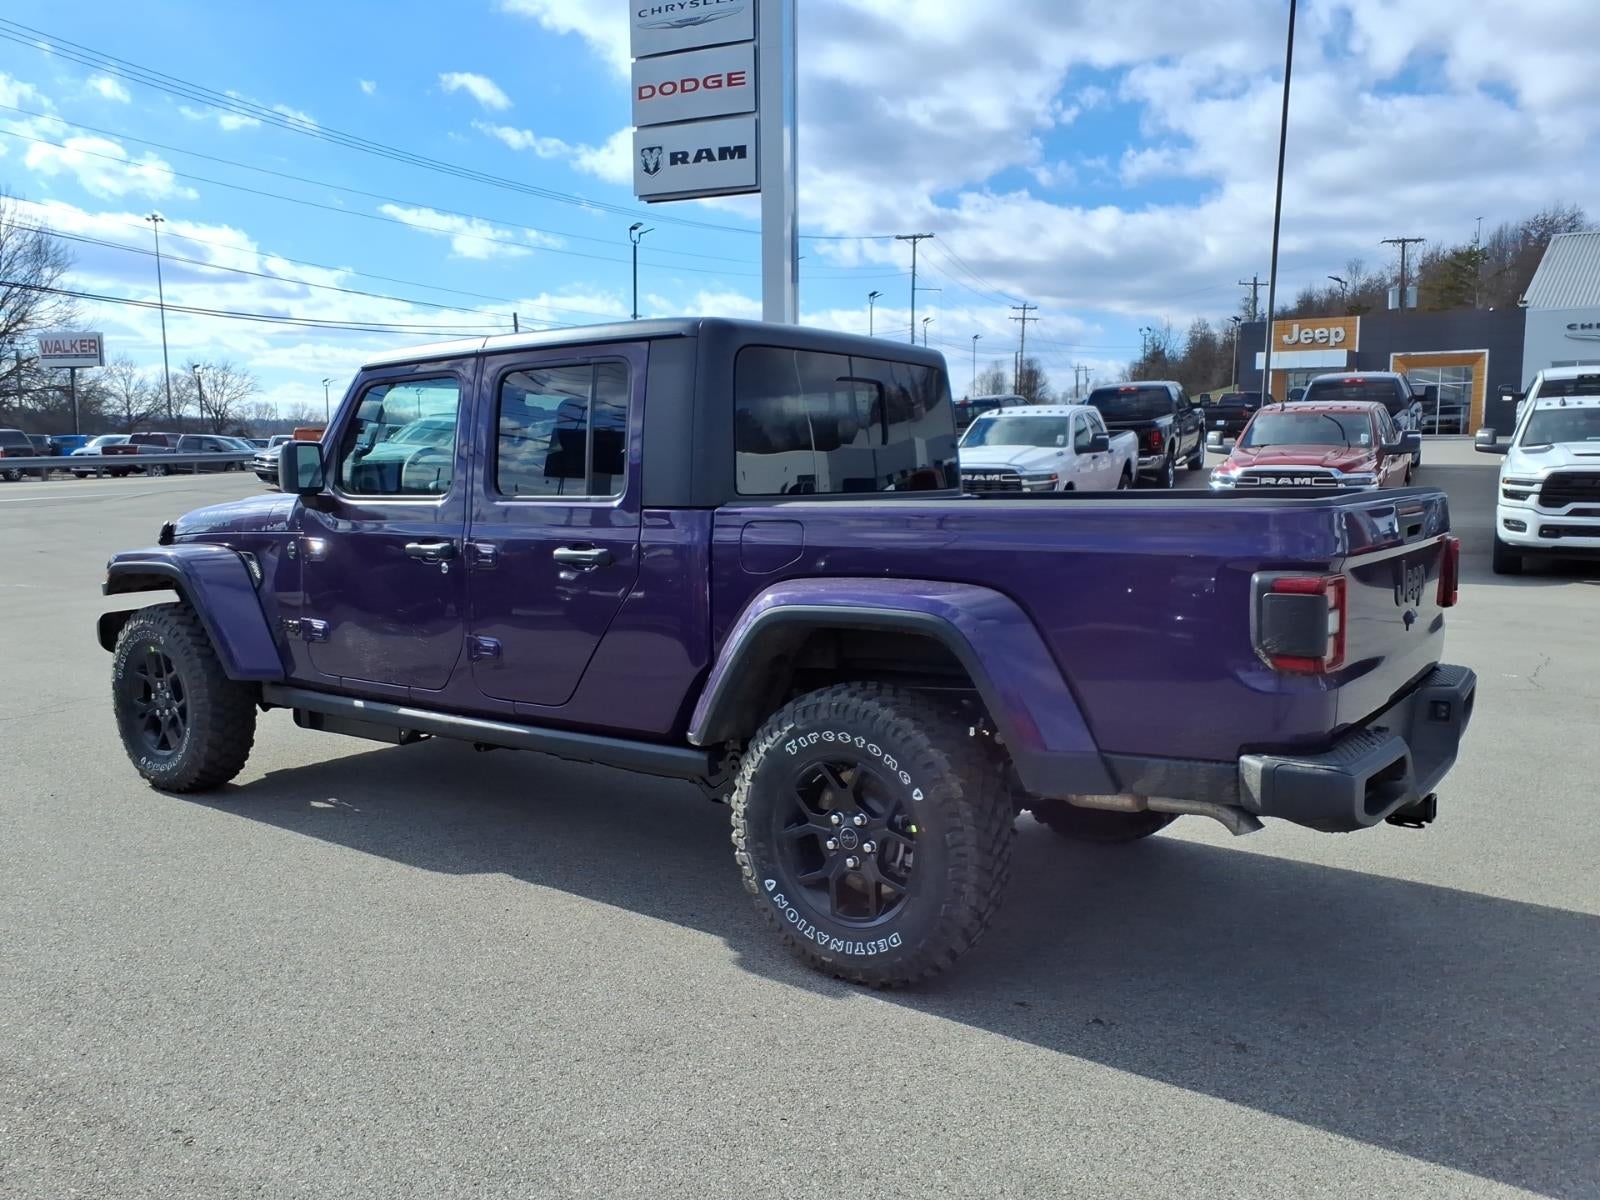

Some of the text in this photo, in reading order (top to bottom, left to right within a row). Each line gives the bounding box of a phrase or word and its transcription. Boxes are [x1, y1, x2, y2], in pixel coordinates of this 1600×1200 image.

[637, 0, 735, 18] CHRYSL
[638, 71, 746, 100] DODGE
[669, 145, 747, 166] RAM
[40, 339, 98, 353] WALKER
[1282, 323, 1346, 347] Jeep
[1260, 477, 1312, 485] RAM
[785, 730, 912, 785] Firestone
[774, 893, 902, 955] DESTINATION
